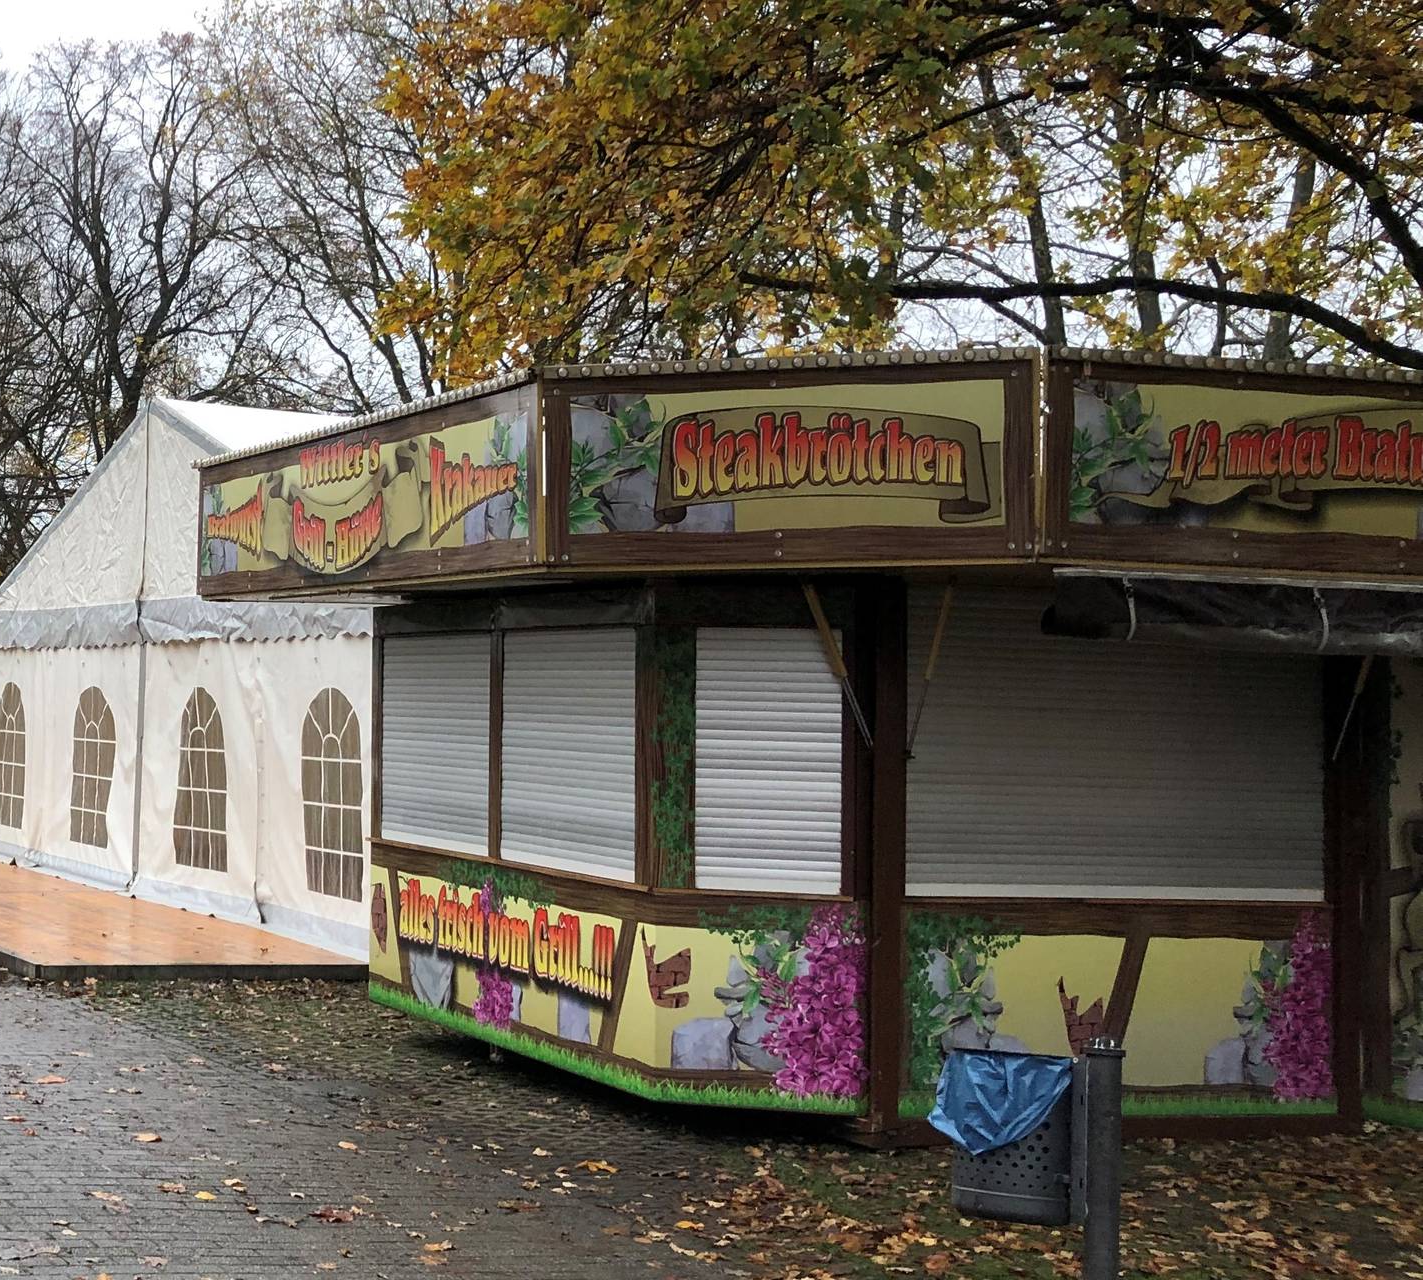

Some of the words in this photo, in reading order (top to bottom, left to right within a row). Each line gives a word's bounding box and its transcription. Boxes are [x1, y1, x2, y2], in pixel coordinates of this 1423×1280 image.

[429, 435, 517, 547] Krakauer
[673, 412, 966, 499] Steakbrötchen
[1166, 419, 1221, 489] 1/2
[1223, 417, 1330, 480] meter
[399, 879, 436, 944] alles
[438, 885, 484, 959] frisch
[488, 911, 530, 973] vom
